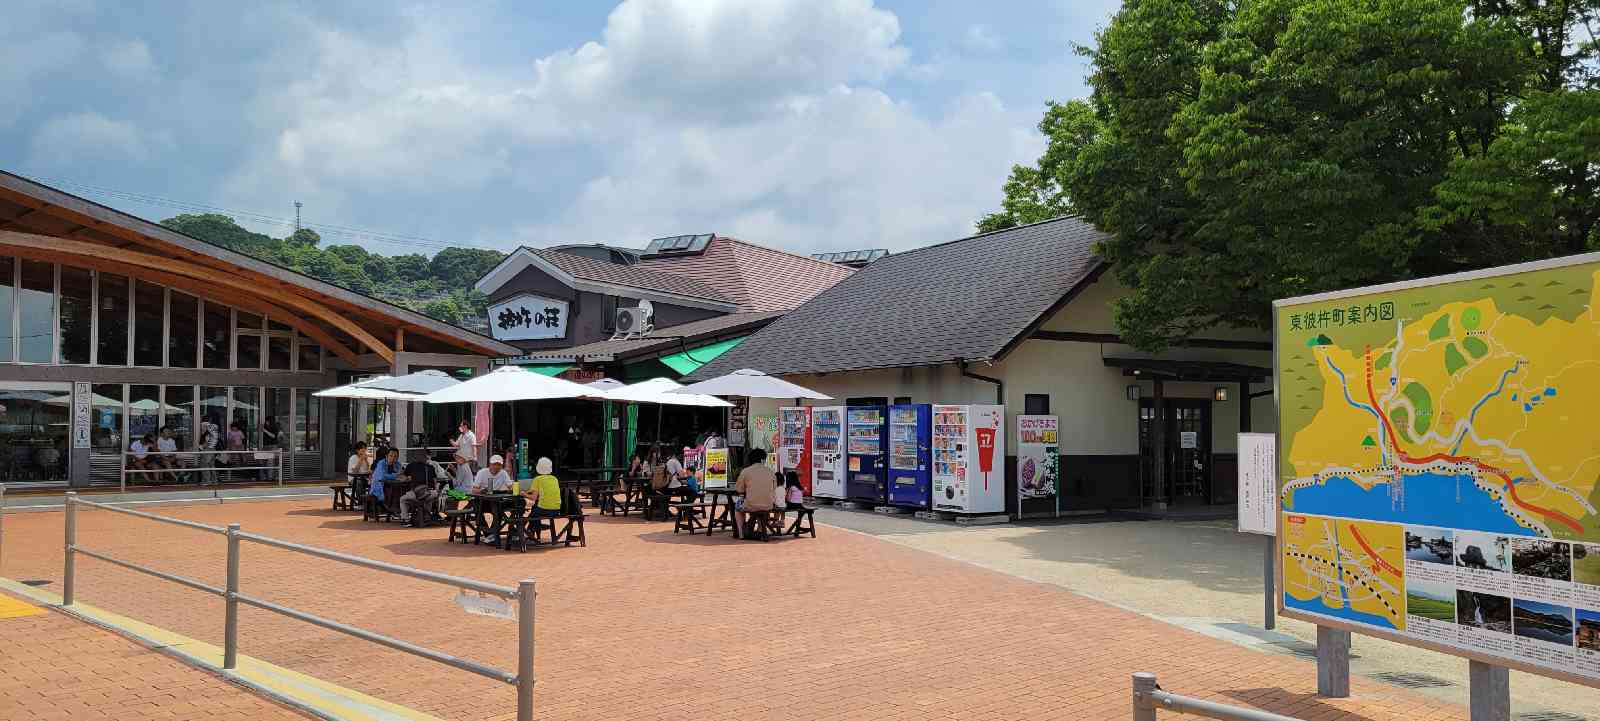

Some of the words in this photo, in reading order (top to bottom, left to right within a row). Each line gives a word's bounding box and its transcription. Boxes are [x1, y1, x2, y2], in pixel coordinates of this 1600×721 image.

[1289, 302, 1395, 332] 東彼杵町案内図
